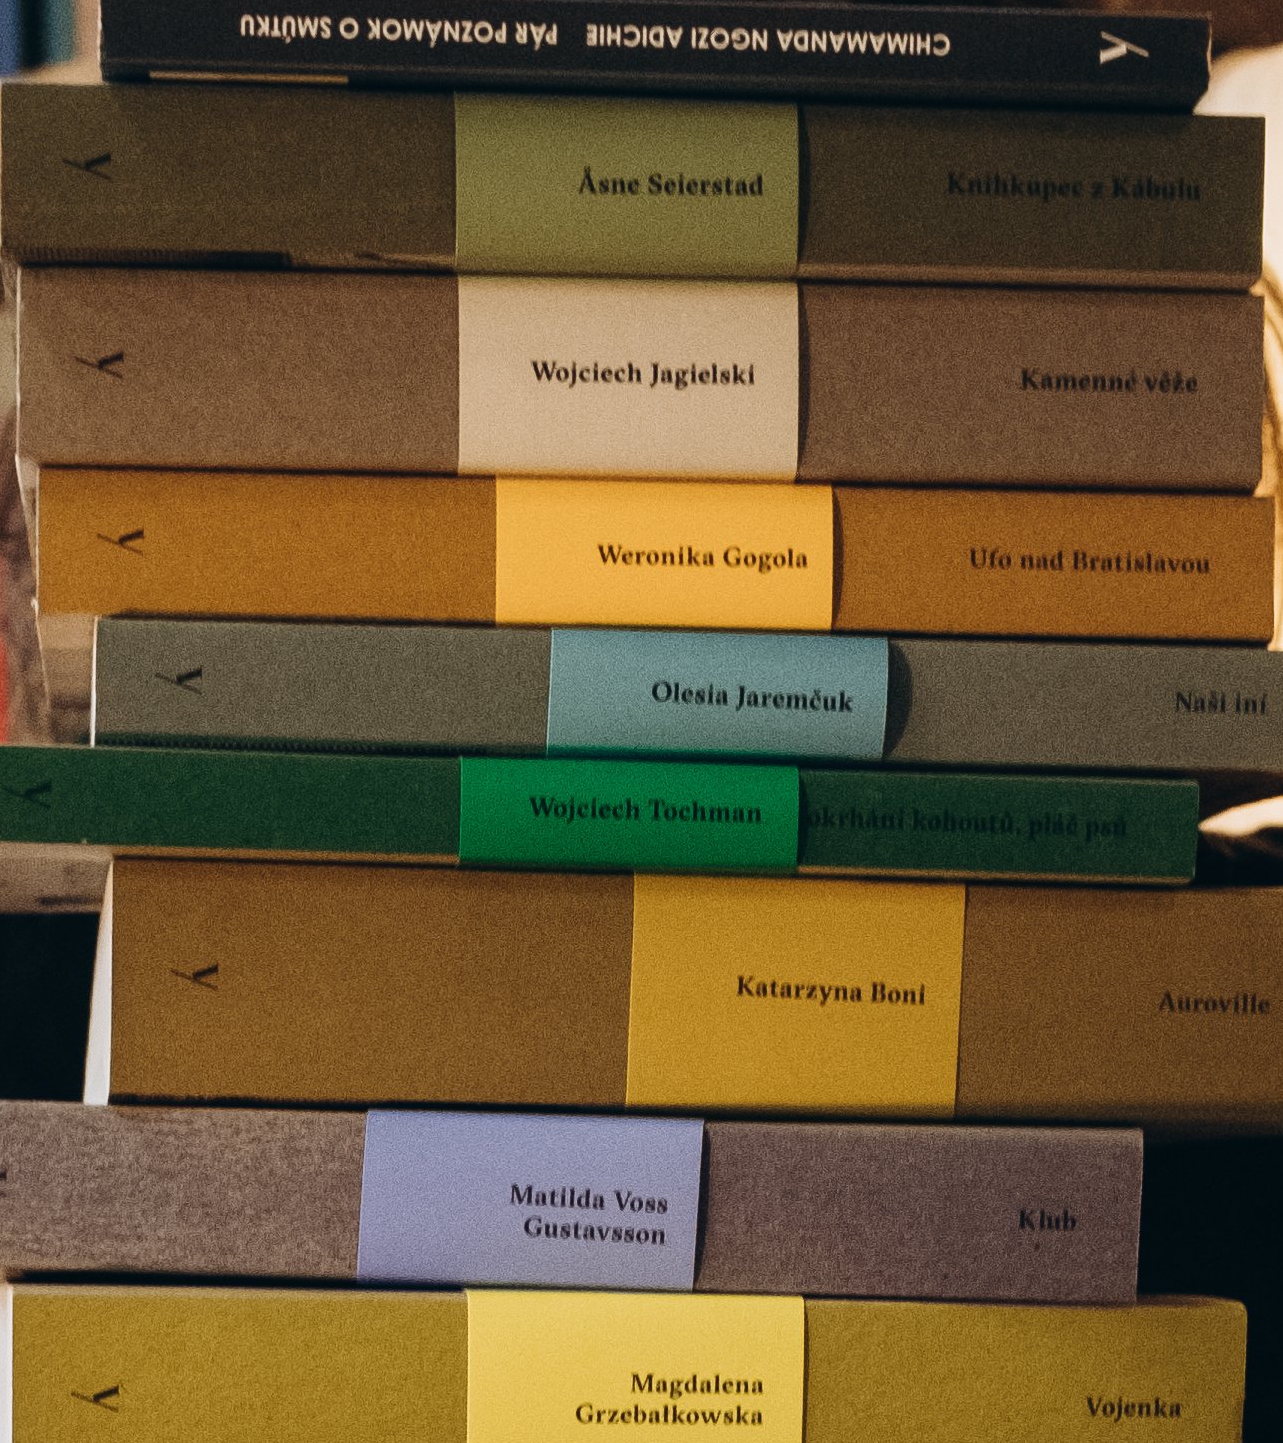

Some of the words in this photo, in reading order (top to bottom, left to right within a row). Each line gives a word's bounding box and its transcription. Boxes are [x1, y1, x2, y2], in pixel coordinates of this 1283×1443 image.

[240, 14, 332, 44] SMÚTKU
[339, 17, 359, 40] O
[368, 18, 507, 48] POZNÁMOK
[515, 22, 557, 51] PÁR
[587, 23, 682, 48] ADICHIE
[691, 27, 768, 51] NGOZI
[777, 29, 951, 57] CHIMAMANDA
[579, 167, 640, 196] Åsne
[647, 173, 764, 198] Seierstad
[1089, 180, 1106, 200] z
[531, 361, 642, 389] Wojciech
[650, 362, 755, 390] Jagielski
[1020, 367, 1138, 393] Kamenné
[598, 544, 715, 568] Weronika
[722, 545, 809, 572] Gogola
[969, 547, 1012, 570] Ufo
[1019, 548, 1064, 571] nad
[1073, 549, 1210, 574] Bratislavou
[651, 679, 728, 707] Olesia
[735, 683, 854, 713] Jaremčuk
[1175, 691, 1226, 713] Naši
[529, 794, 641, 823] Wojciech
[648, 798, 762, 825] Tochman
[808, 805, 905, 830] okrhání
[737, 974, 863, 1006] Katarzyna
[871, 980, 926, 1006] Boni
[1159, 989, 1270, 1015] Auroville
[509, 1182, 605, 1212] Matilda
[613, 1189, 668, 1215] Voss
[523, 1216, 666, 1246] Gustavsson
[1019, 1208, 1077, 1232] Klub
[630, 1372, 764, 1399] Magdalena
[1087, 1396, 1183, 1421] Vojenka
